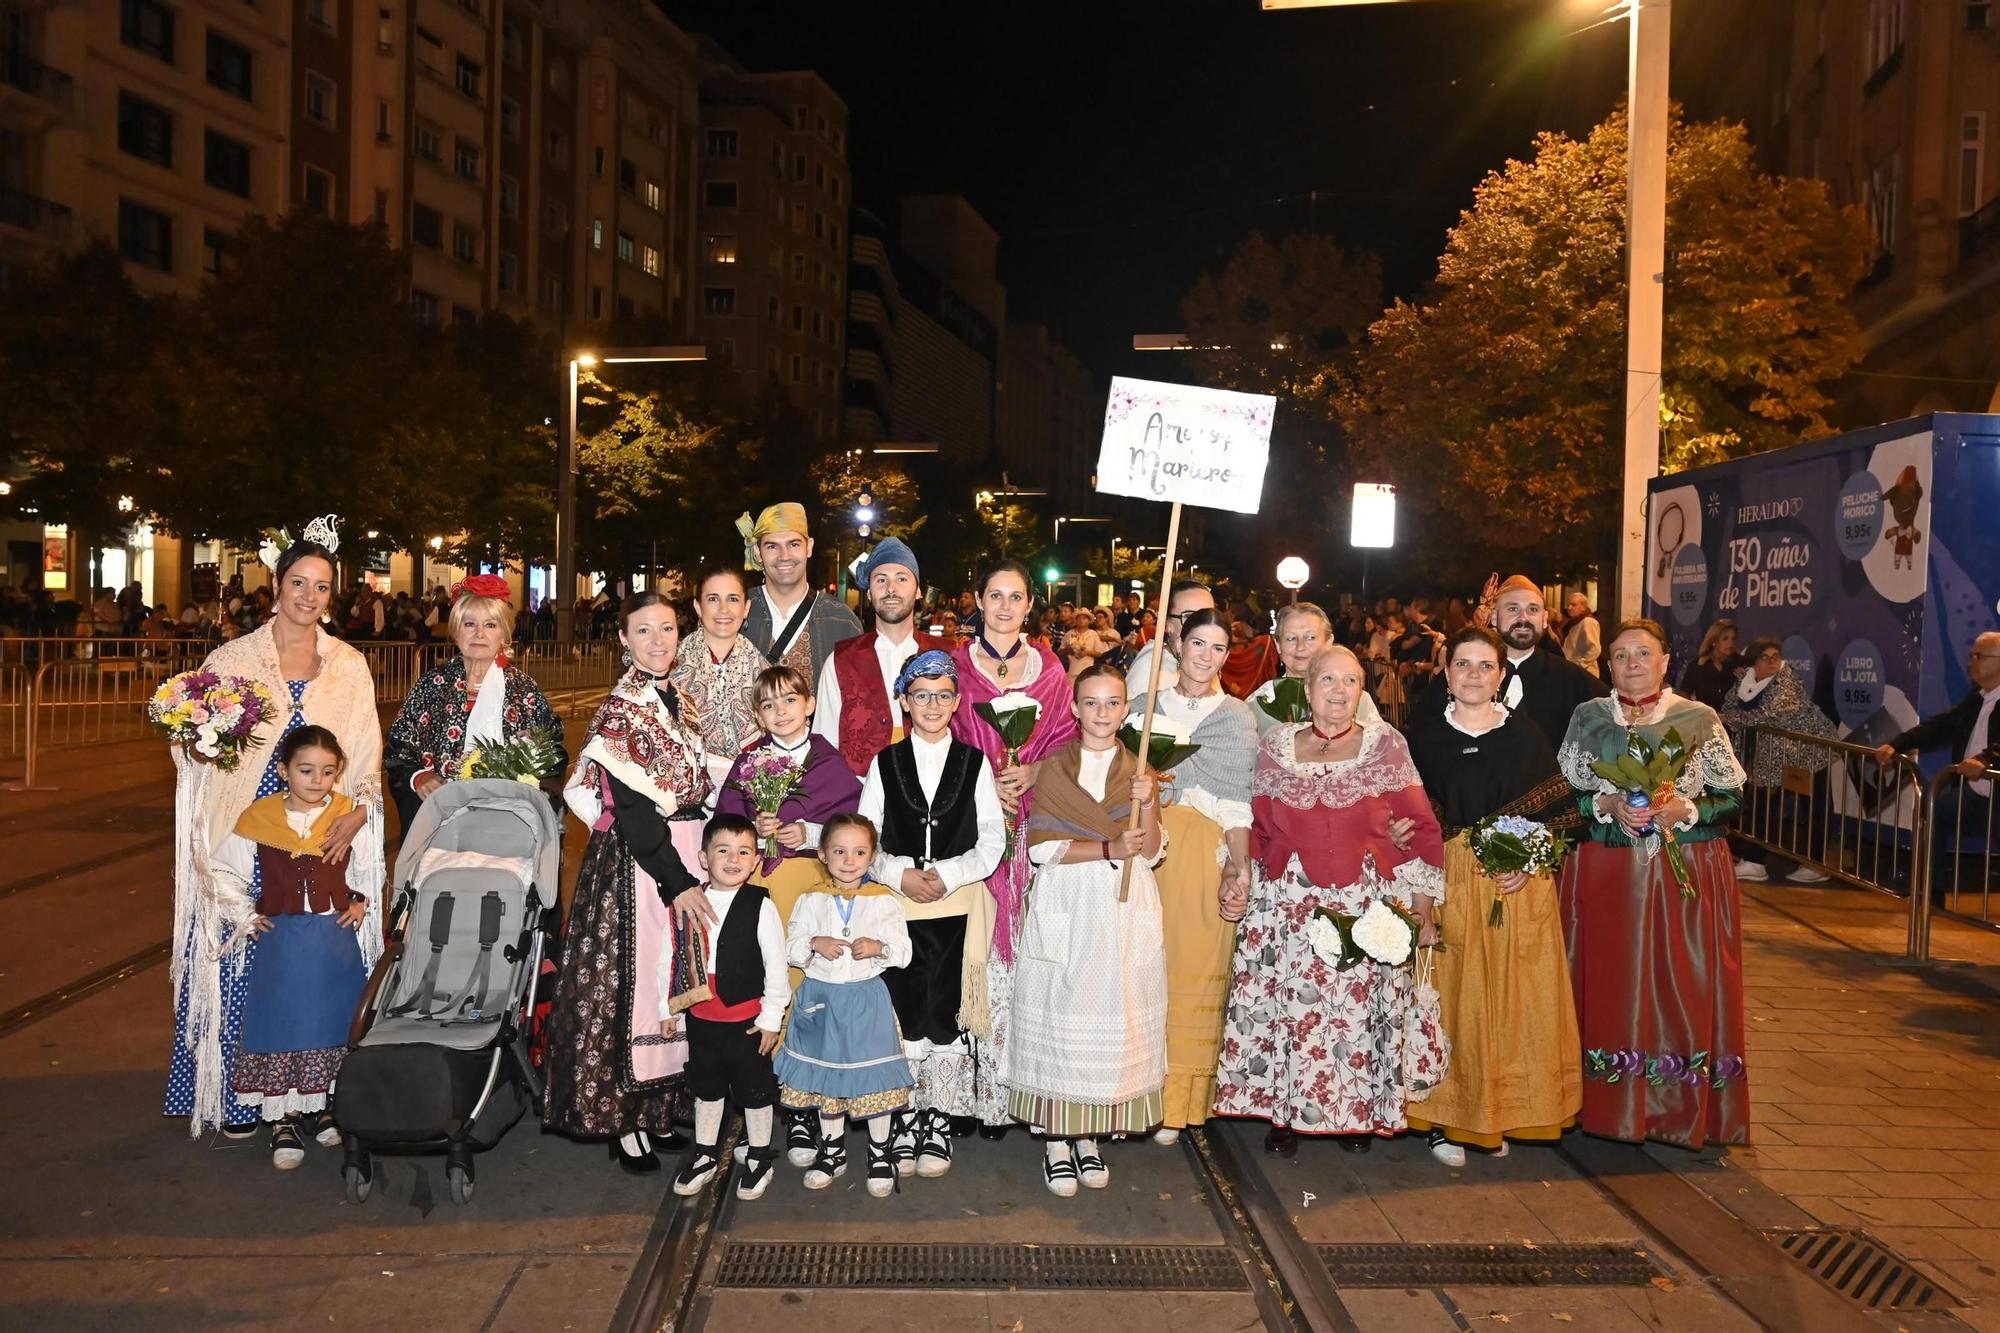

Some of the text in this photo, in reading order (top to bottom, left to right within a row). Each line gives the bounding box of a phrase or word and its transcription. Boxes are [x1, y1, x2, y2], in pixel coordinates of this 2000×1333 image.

[1737, 499, 1790, 524] HERALDO
[1728, 537, 1810, 573] 130 años
[1719, 571, 1812, 609] de Pilares
[1846, 657, 1873, 669] LIBRO
[1840, 670, 1878, 683] LA JOTA
